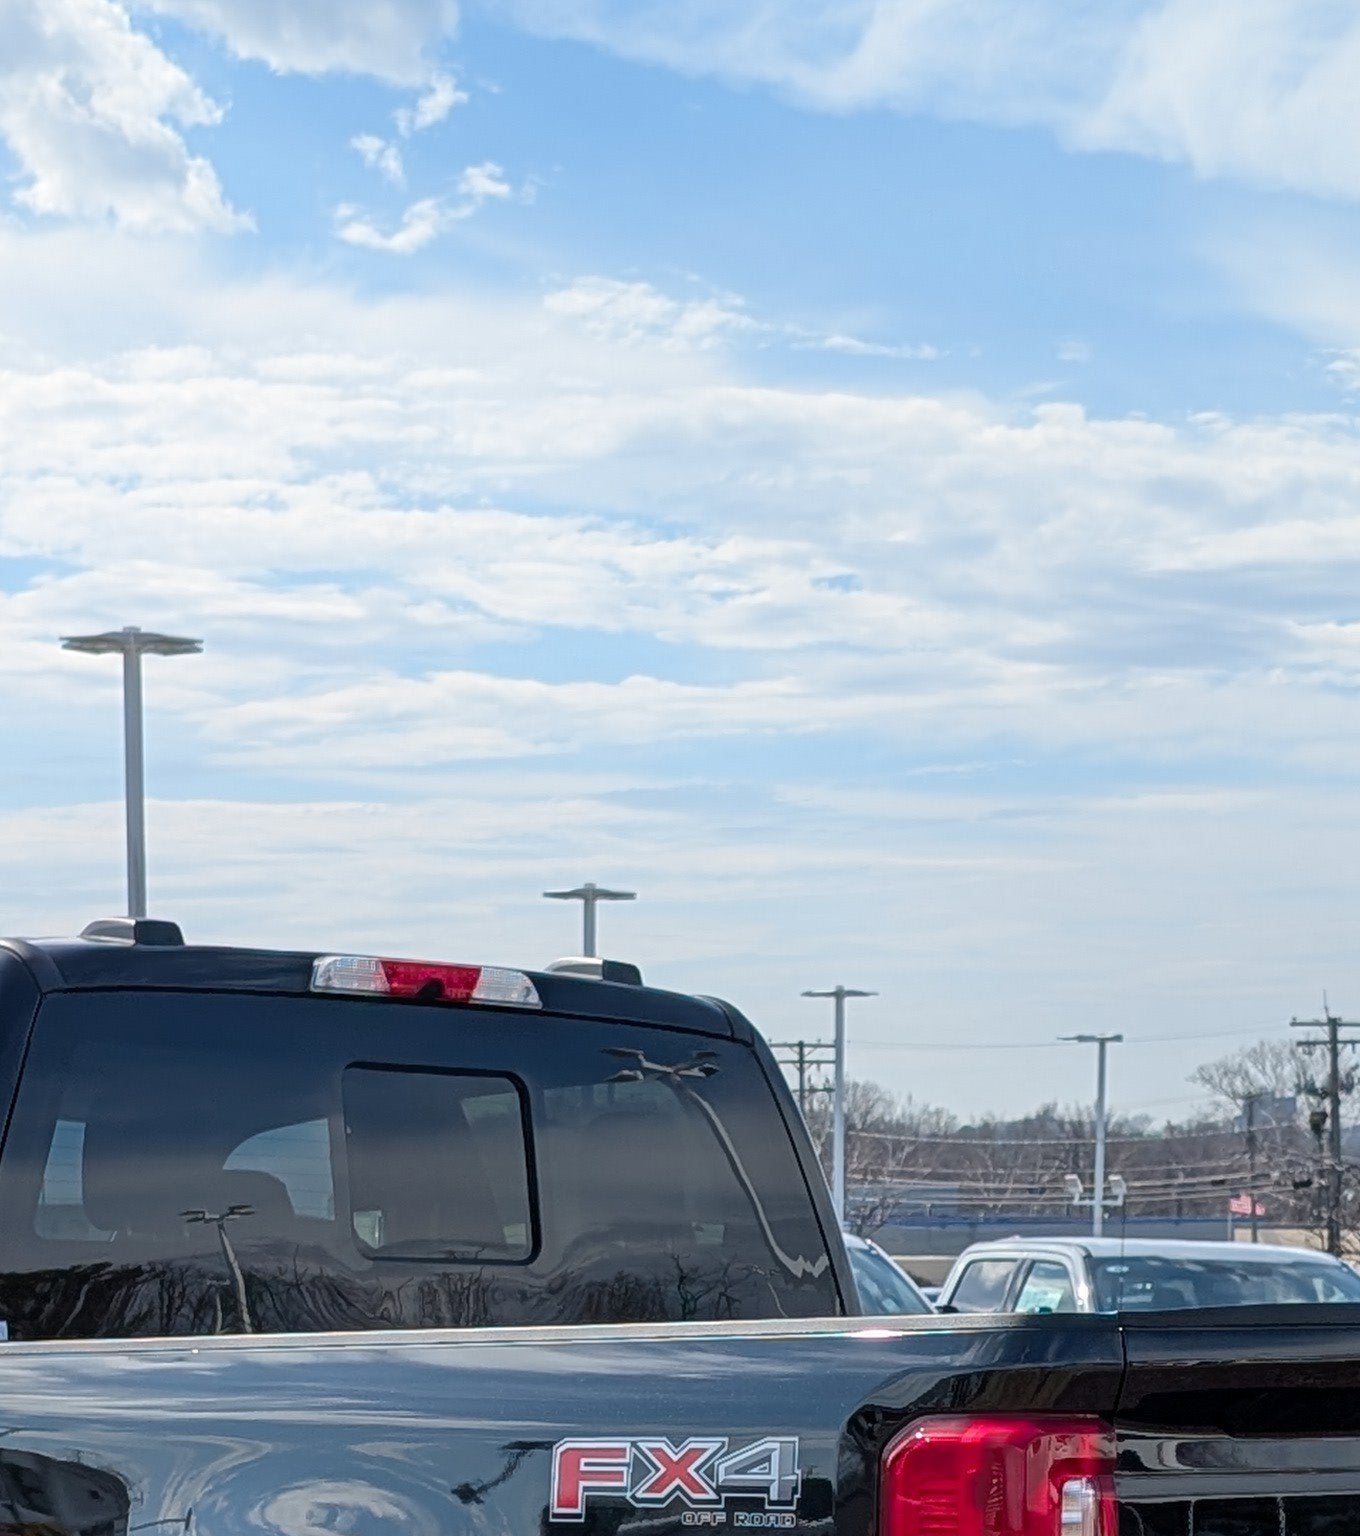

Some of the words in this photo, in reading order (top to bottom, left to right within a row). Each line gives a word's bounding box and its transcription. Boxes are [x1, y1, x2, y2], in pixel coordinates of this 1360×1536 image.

[549, 1436, 802, 1523] FX4
[681, 1511, 727, 1527] OFF
[733, 1511, 797, 1529] ROAD
